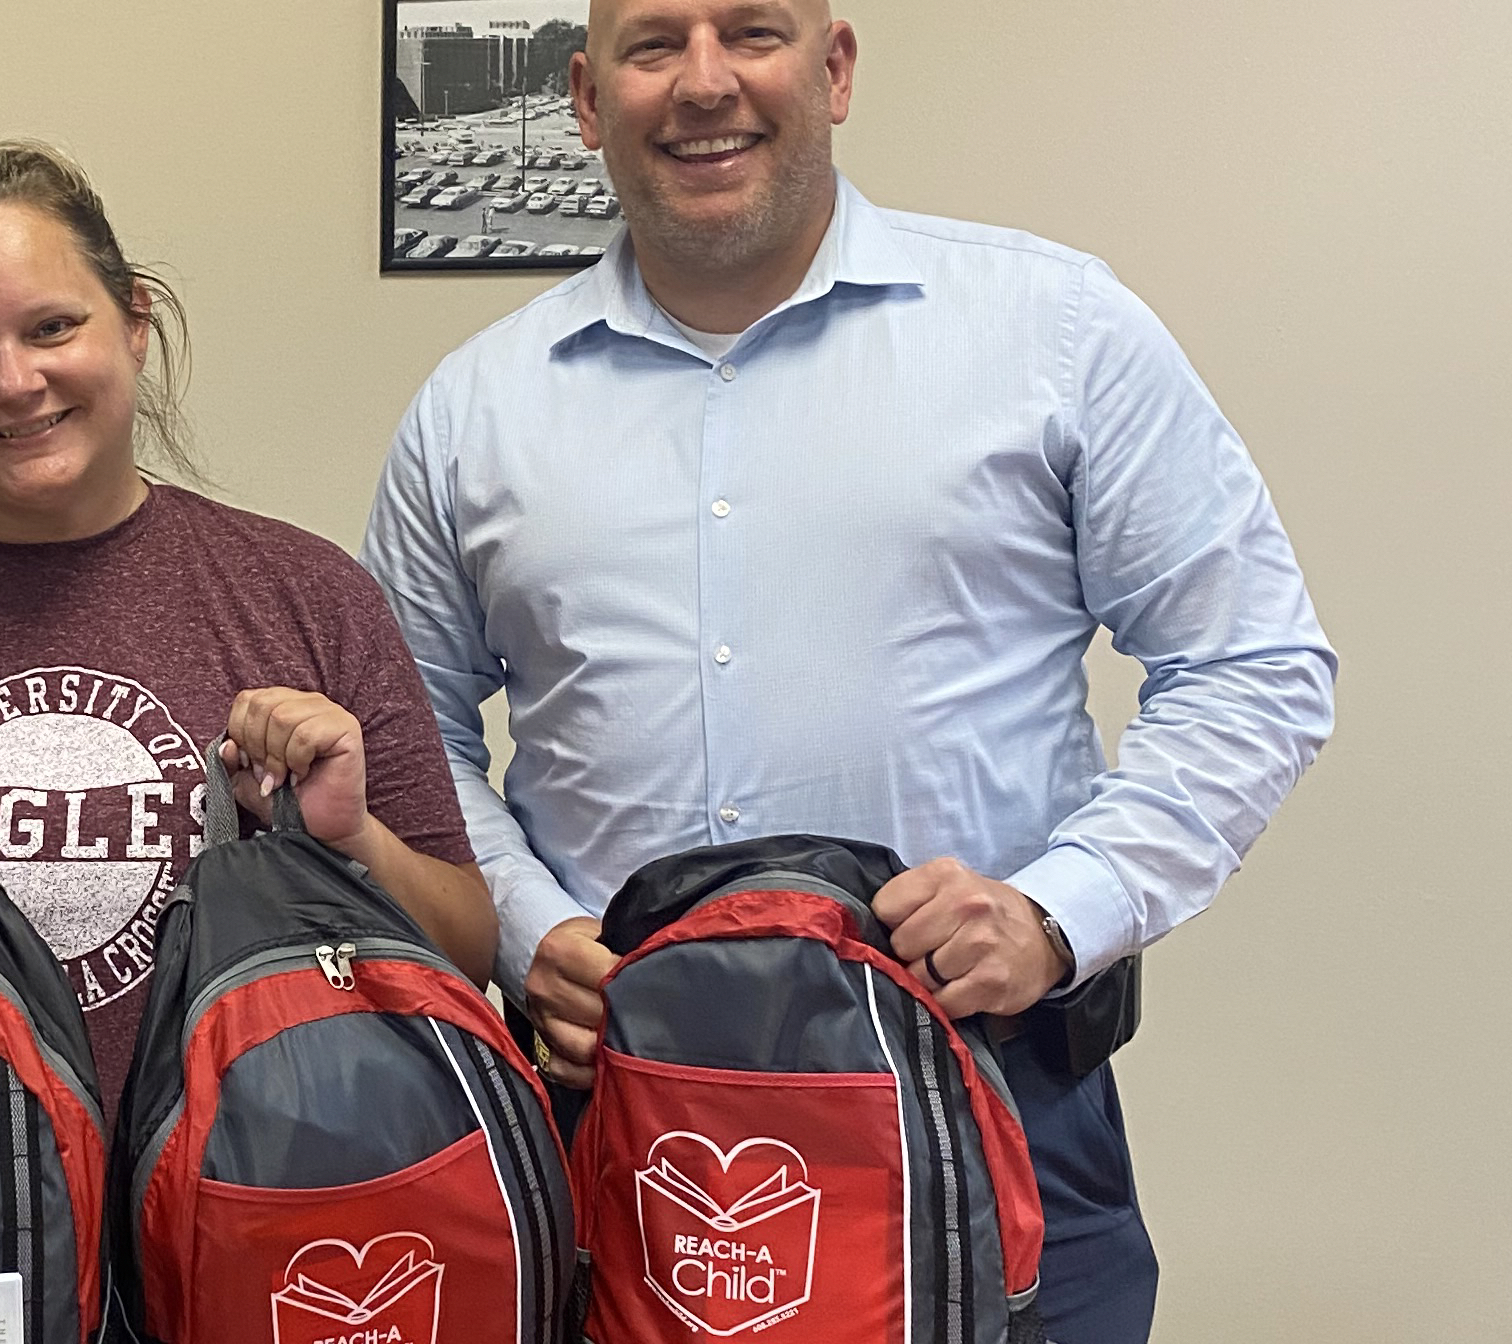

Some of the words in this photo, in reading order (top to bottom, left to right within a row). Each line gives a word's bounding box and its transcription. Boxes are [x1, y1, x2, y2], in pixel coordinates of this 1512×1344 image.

[147, 733, 199, 772] OF
[64, 959, 107, 1006] A
[674, 1233, 774, 1264] REACH-A
